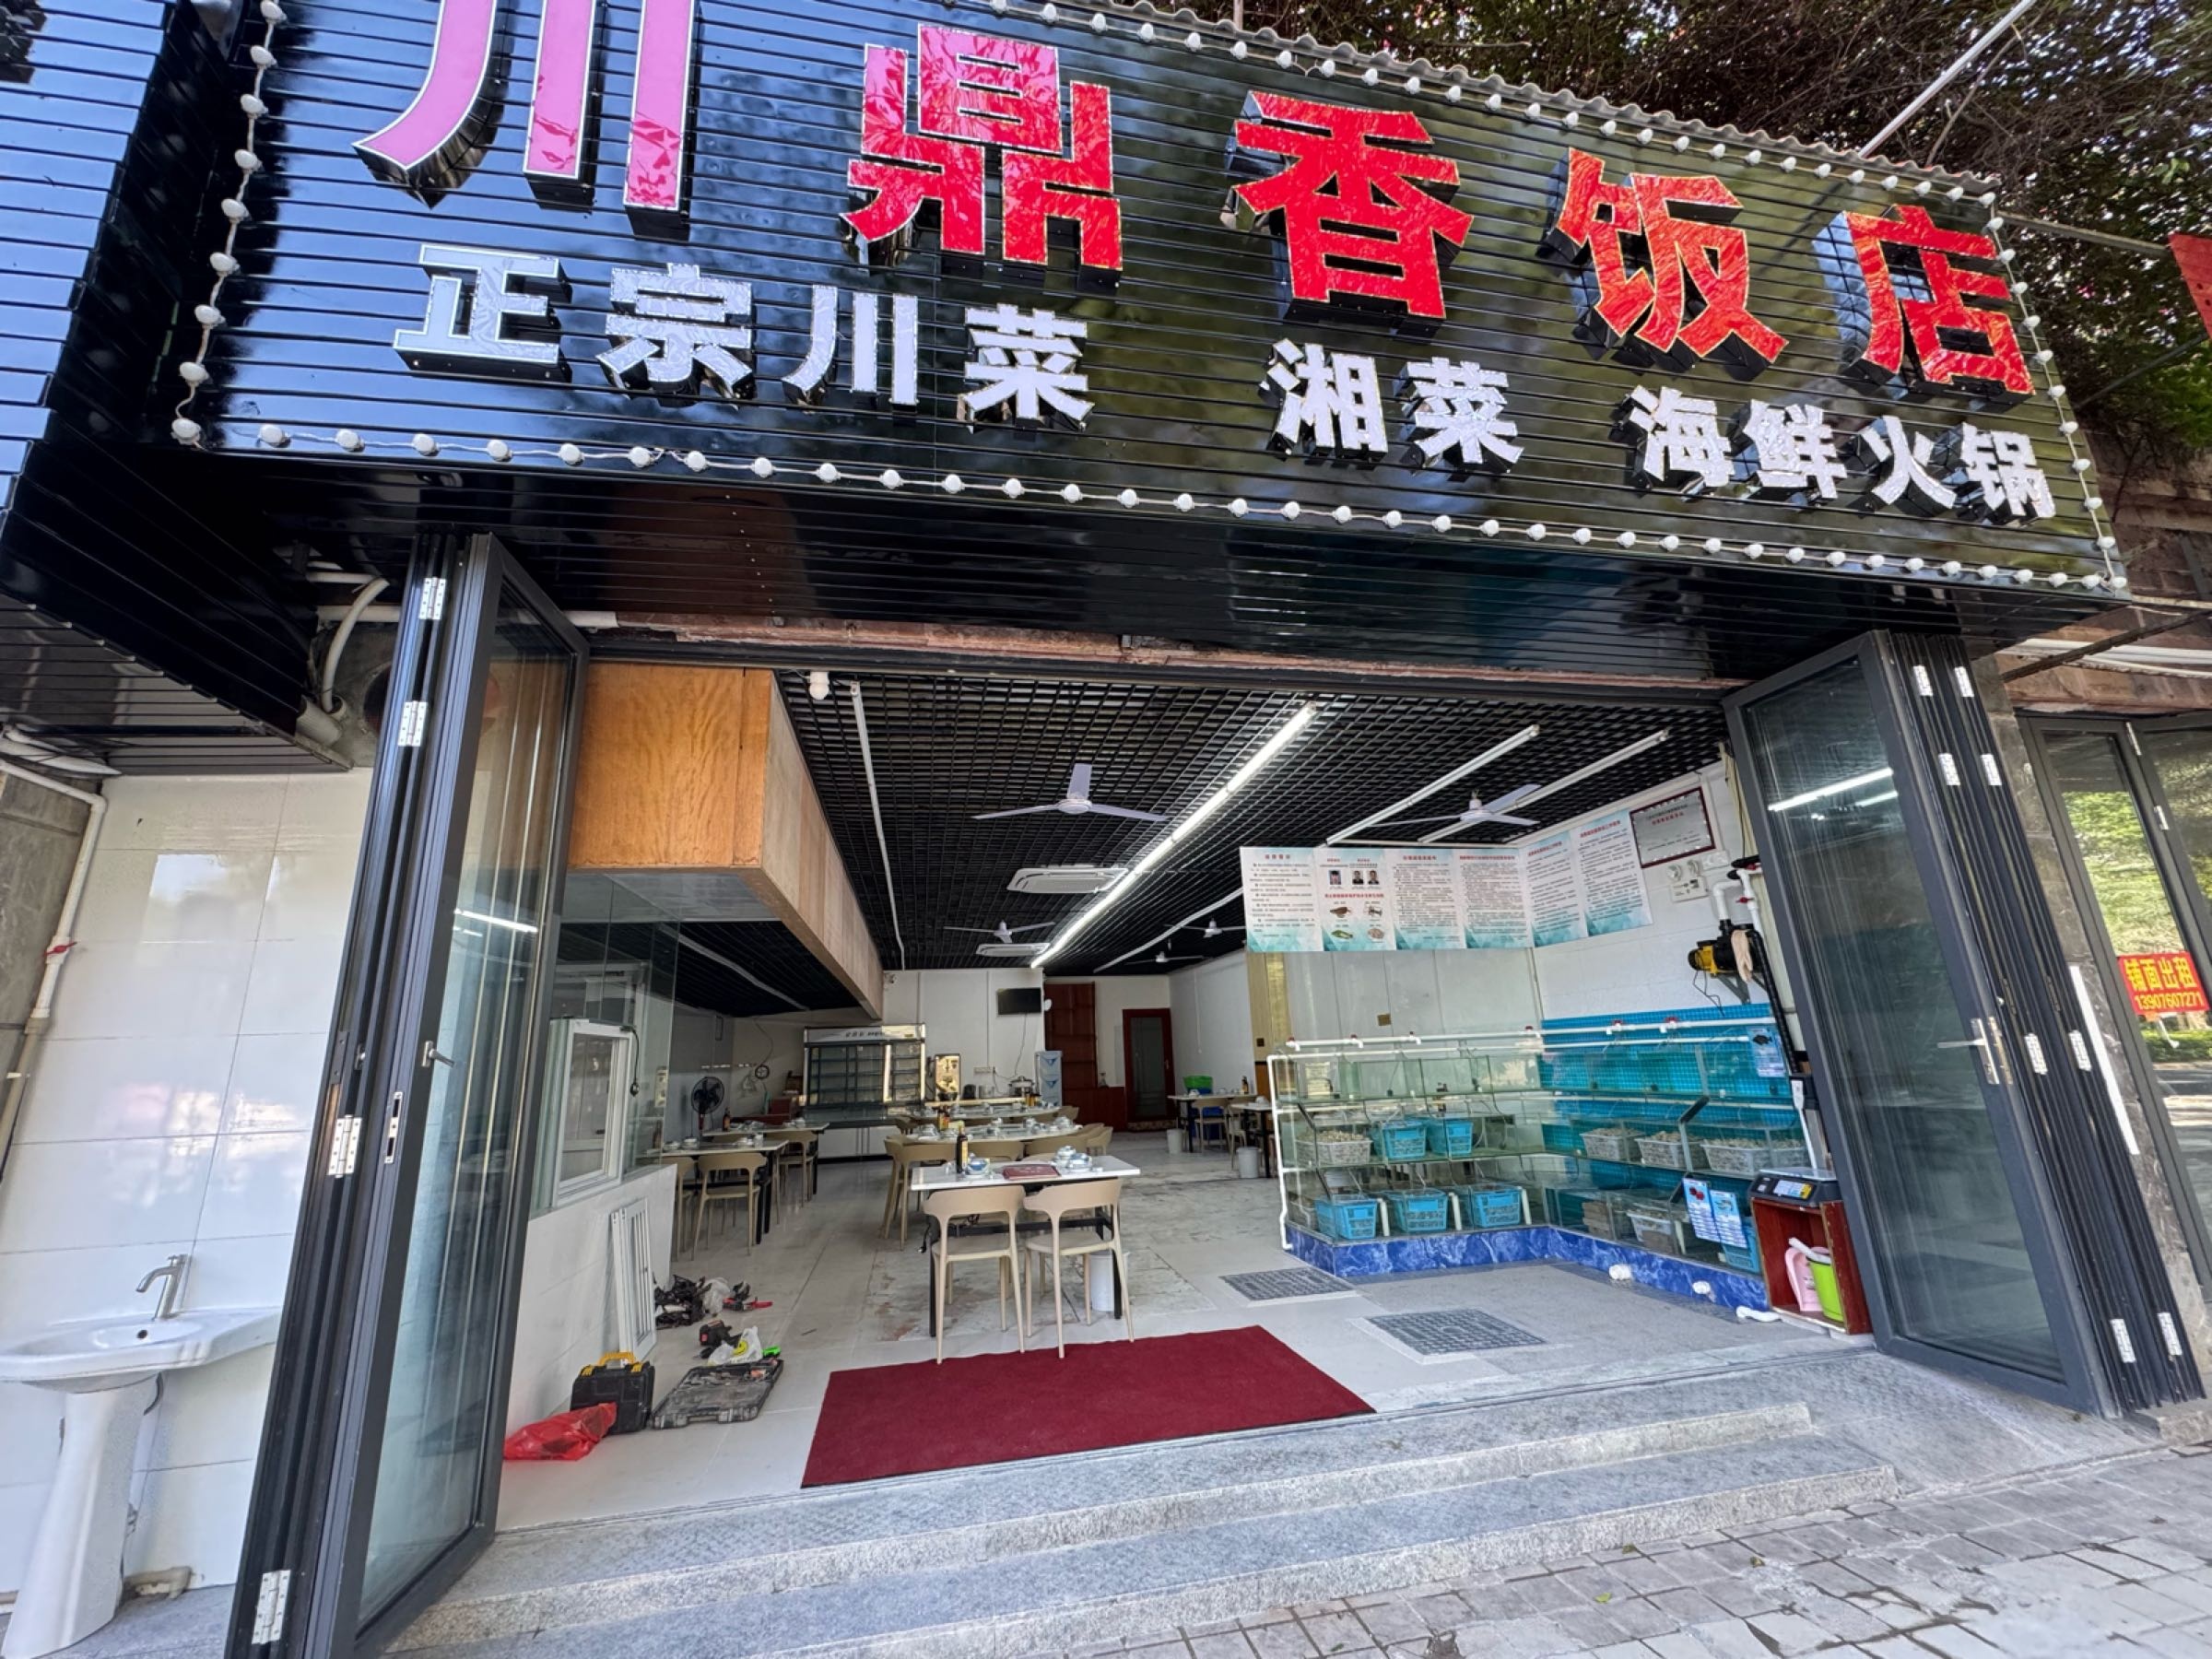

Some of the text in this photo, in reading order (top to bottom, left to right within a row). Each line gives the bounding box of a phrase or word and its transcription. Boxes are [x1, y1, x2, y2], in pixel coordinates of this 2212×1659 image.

[353, 0, 2035, 394] 川鼎香饭店
[394, 244, 2055, 519] 正宗川菜 湘菜 海鲜火锅
[2124, 957, 2197, 991] 铺面出租
[2135, 992, 2205, 1010] 13907607271
